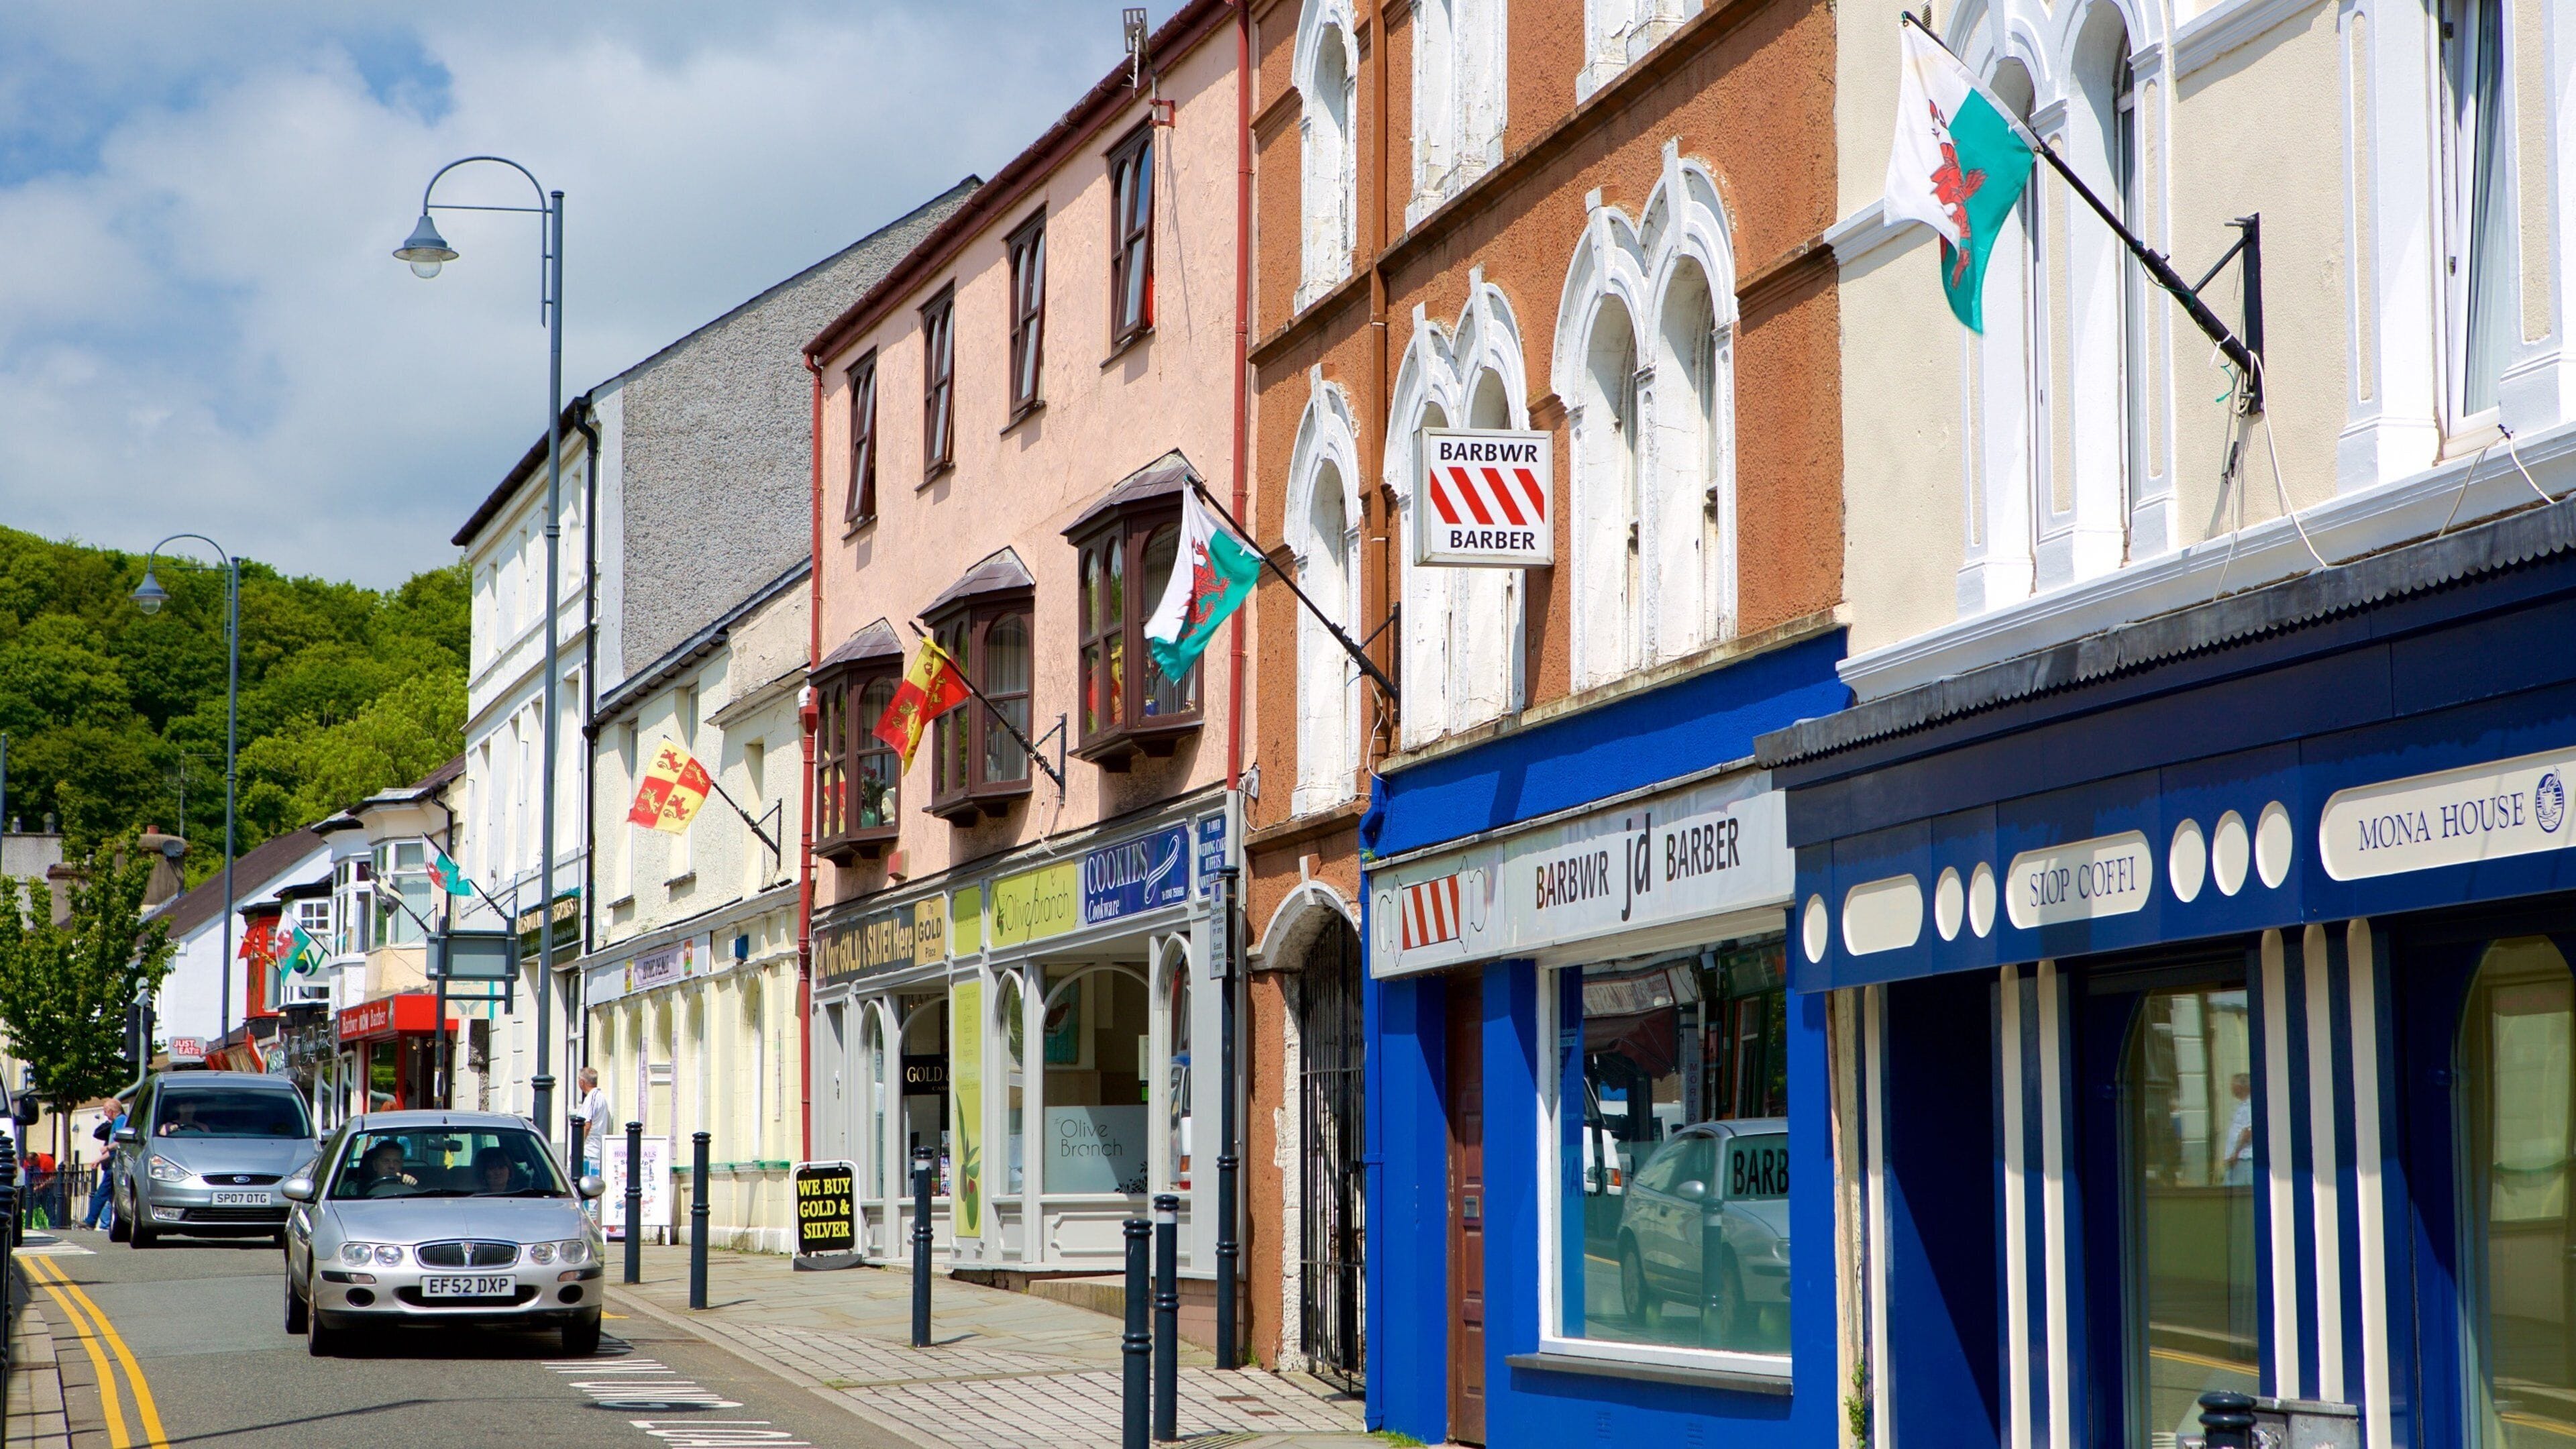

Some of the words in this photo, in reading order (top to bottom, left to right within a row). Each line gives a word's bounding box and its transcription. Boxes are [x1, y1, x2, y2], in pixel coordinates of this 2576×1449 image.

[1440, 442, 1538, 463] BARBWR
[1450, 530, 1536, 550] BARBER
[2358, 810, 2432, 851] MONA
[2440, 792, 2526, 839] HOUSE
[1087, 841, 1148, 895] COOKIES
[1205, 854, 1222, 871] BUFFETS
[1536, 850, 1610, 910] BARBWR
[1621, 812, 1651, 922] jd
[1666, 817, 1741, 882] BARBER
[2030, 868, 2070, 907] SIOP
[2078, 856, 2136, 899] COFFI
[1006, 894, 1030, 931] Olive
[1087, 897, 1120, 922] Cookware
[918, 916, 942, 943] GOLD
[826, 936, 839, 977] Your
[840, 929, 861, 973] GOLD
[867, 920, 893, 967] SILVER
[894, 918, 913, 961] Here
[925, 947, 936, 958] Place
[370, 1006, 386, 1028] Barber
[174, 1039, 195, 1047] JUST
[178, 1046, 194, 1055] EAT
[907, 1066, 943, 1083] GOLD
[1060, 1119, 1108, 1138] Olive
[1061, 1138, 1122, 1157] Branch
[797, 1179, 820, 1196] WE
[823, 1177, 851, 1194] BUY
[217, 1193, 244, 1203] SP07
[247, 1193, 266, 1203] OTG
[799, 1199, 837, 1218] GOLD
[839, 1198, 850, 1216] &
[804, 1221, 851, 1239] SILVER
[429, 1279, 472, 1293] EF52
[477, 1278, 508, 1293] DXP
